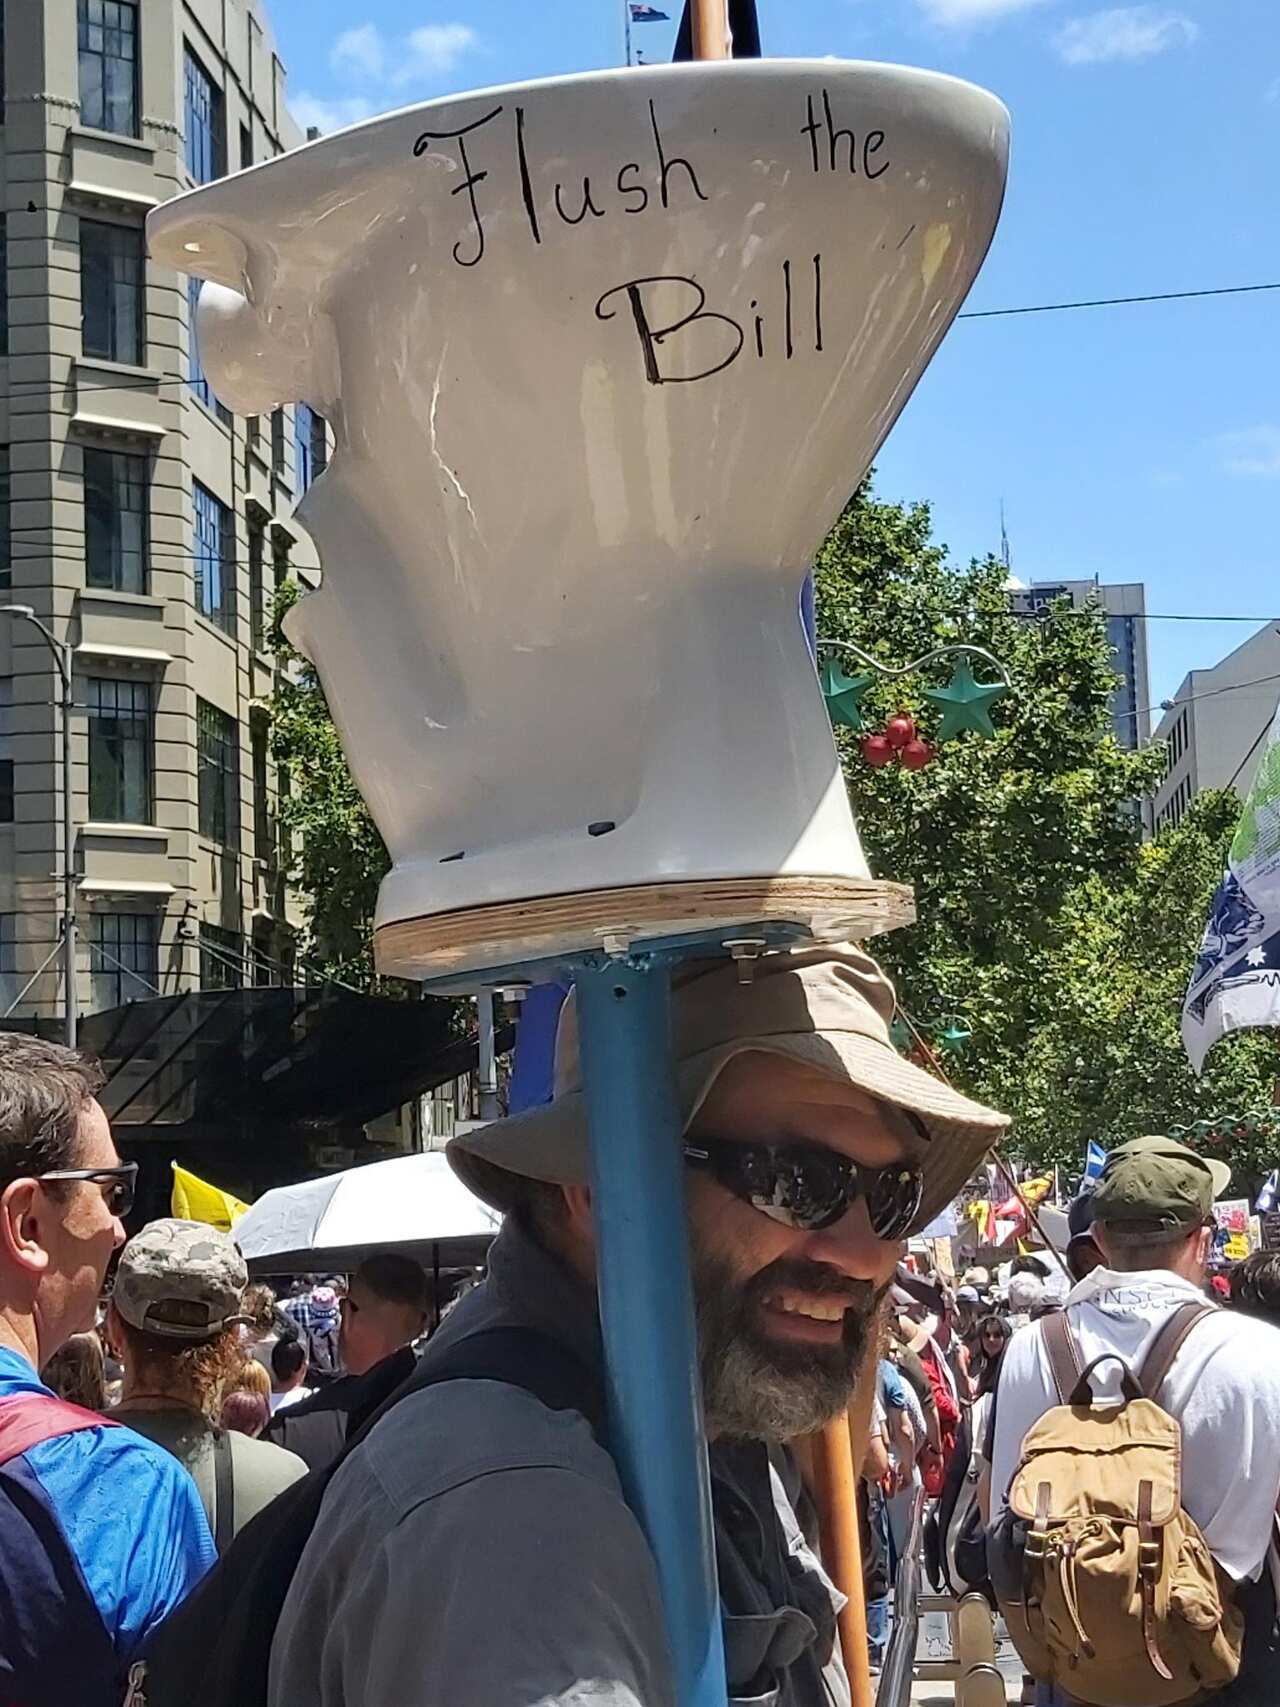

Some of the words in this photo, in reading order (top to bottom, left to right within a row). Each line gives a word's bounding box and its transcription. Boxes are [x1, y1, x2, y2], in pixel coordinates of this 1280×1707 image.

[413, 98, 709, 266] Flush
[801, 88, 890, 180] the
[595, 254, 823, 384] Bill
